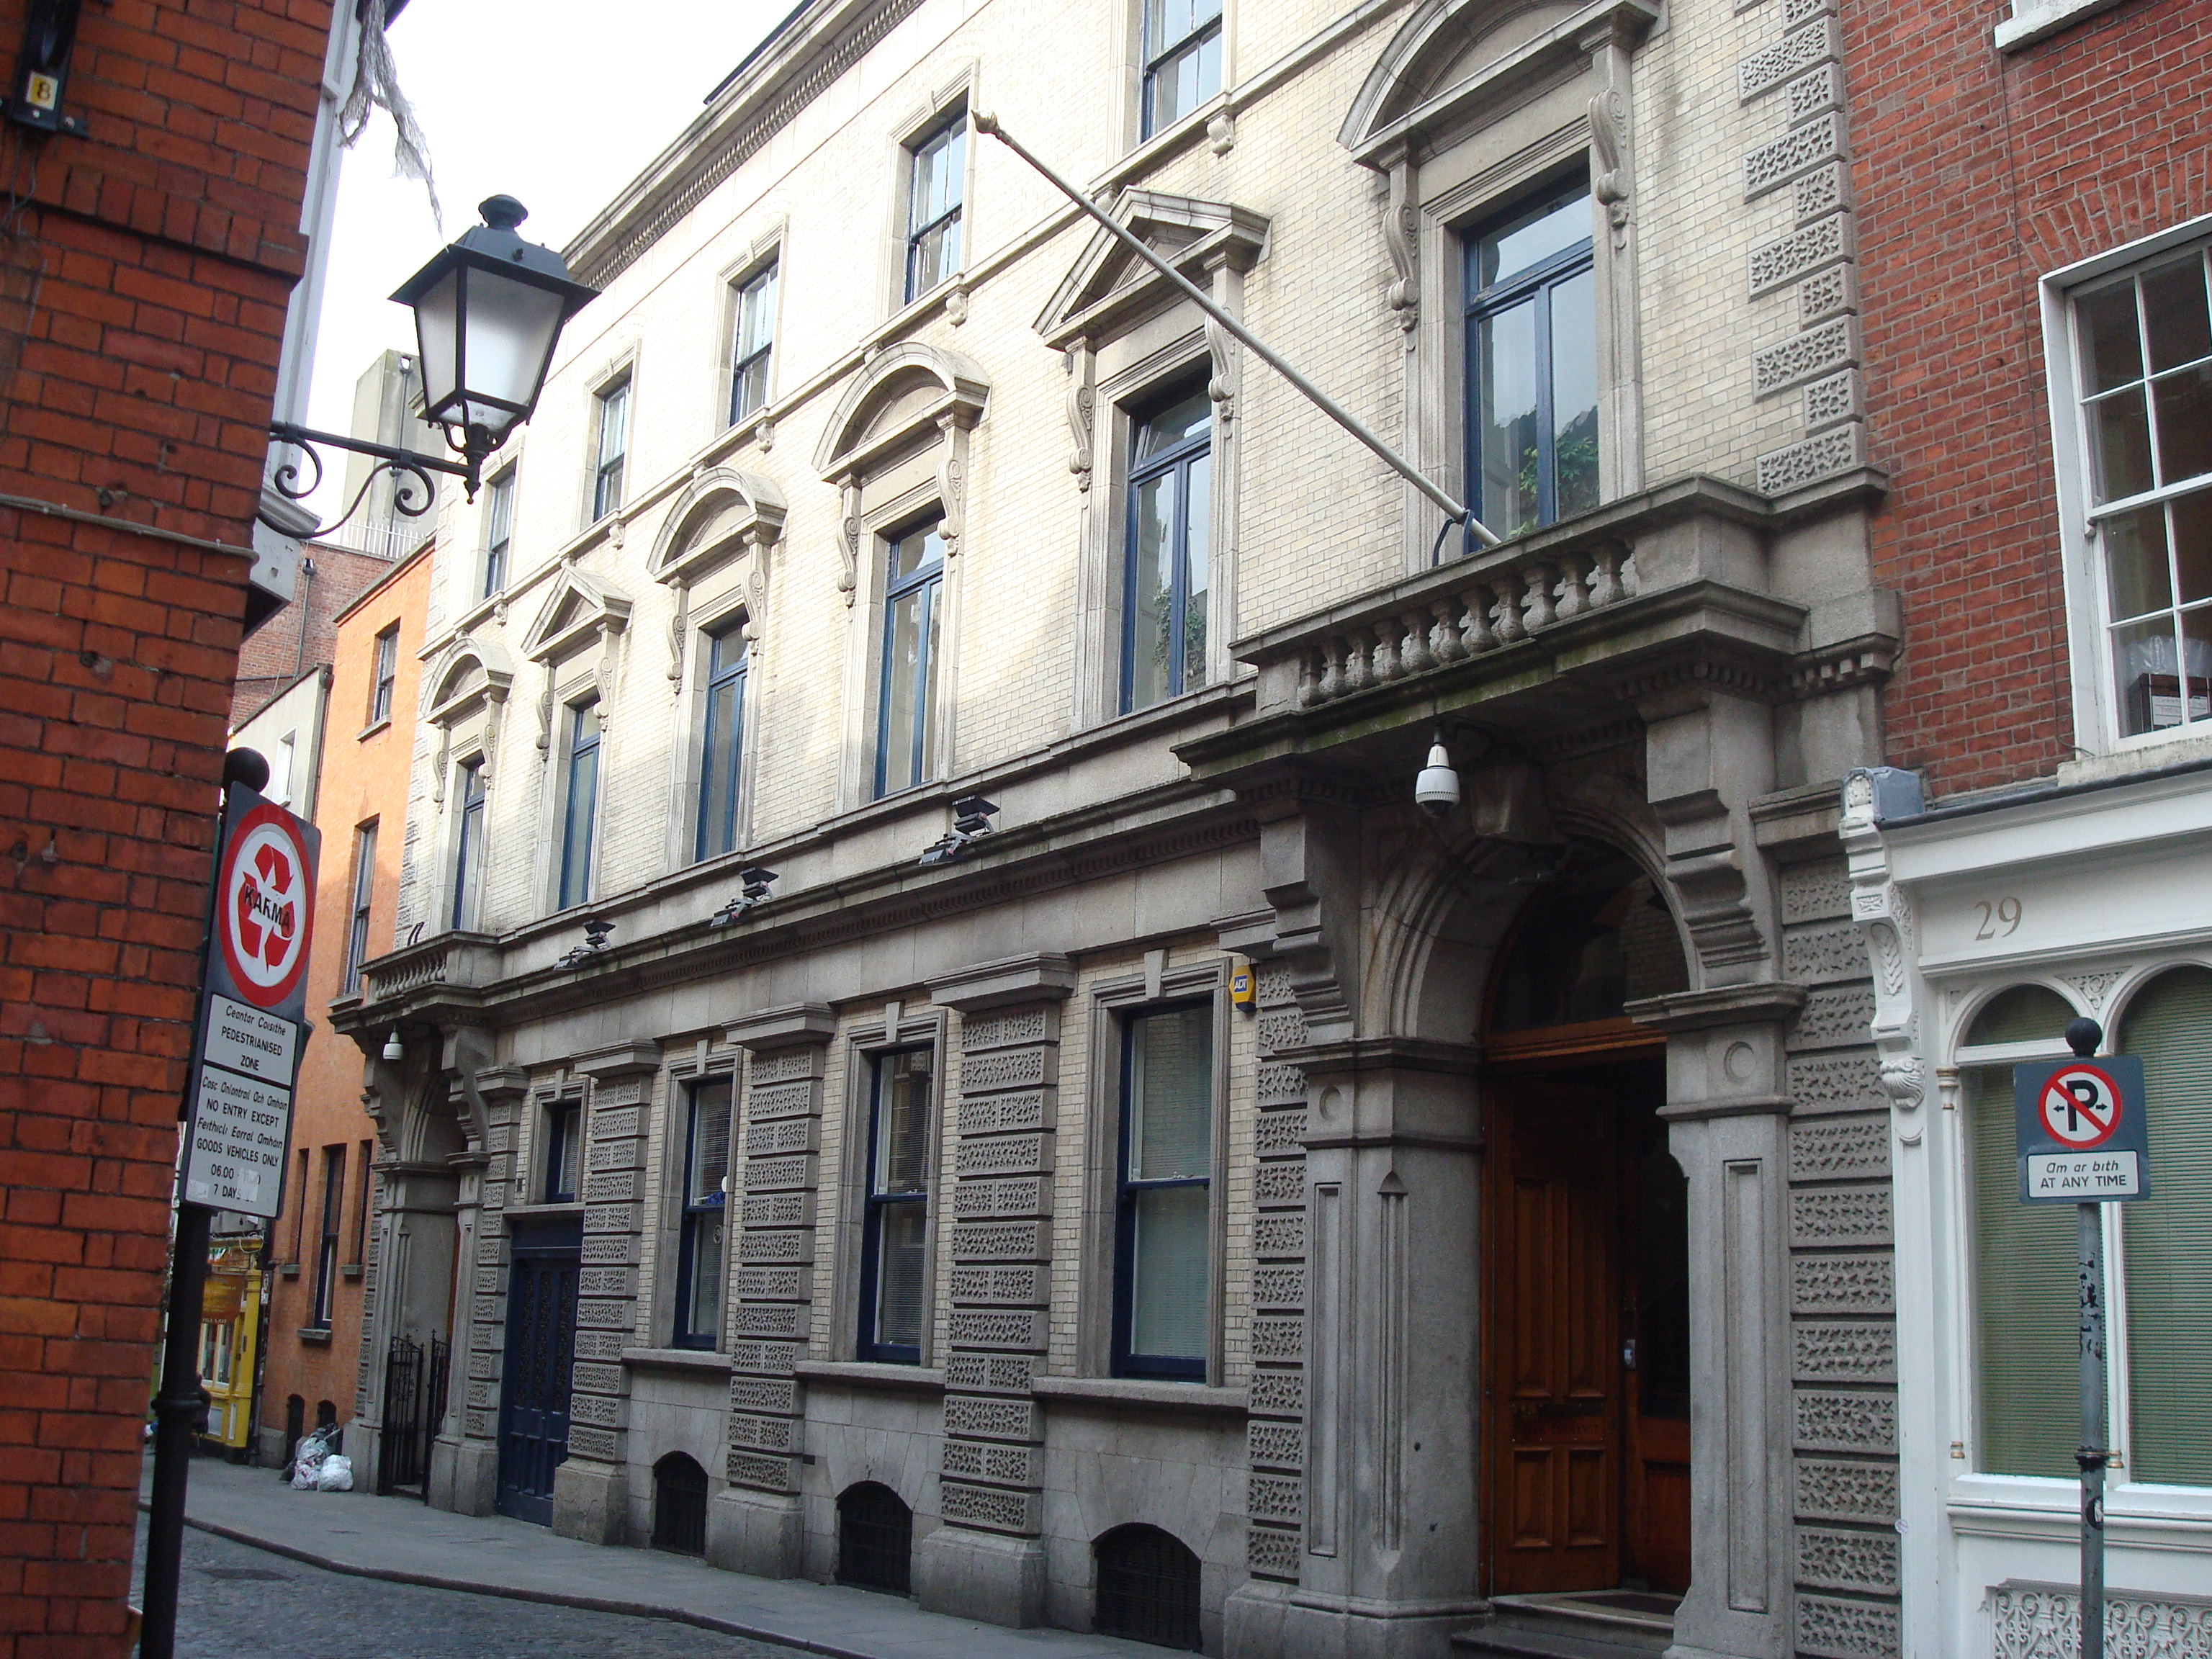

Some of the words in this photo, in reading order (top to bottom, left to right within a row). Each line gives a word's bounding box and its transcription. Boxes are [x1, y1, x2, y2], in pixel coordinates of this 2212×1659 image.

[243, 884, 290, 931] KARMA
[1974, 896, 2022, 940] 29
[1233, 978, 1248, 991] ADT
[226, 1005, 255, 1024] Ceantar
[221, 1025, 282, 1056] PEDESTRIANISED
[240, 1055, 260, 1071] ZONE
[202, 1076, 218, 1090] Cosc
[207, 1097, 219, 1112] NO
[222, 1102, 248, 1119] ENTRY
[251, 1110, 279, 1128] EXCEPT
[197, 1138, 222, 1154] GOODS
[228, 1144, 258, 1162] VEHICLES
[262, 1154, 279, 1166] ONLY
[211, 1164, 235, 1179] 06.00
[2074, 1164, 2087, 1172] ar
[214, 1184, 218, 1195] 7
[2040, 1177, 2056, 1188] AT
[2062, 1176, 2089, 1188] ANY
[2095, 1175, 2127, 1187] TIME
